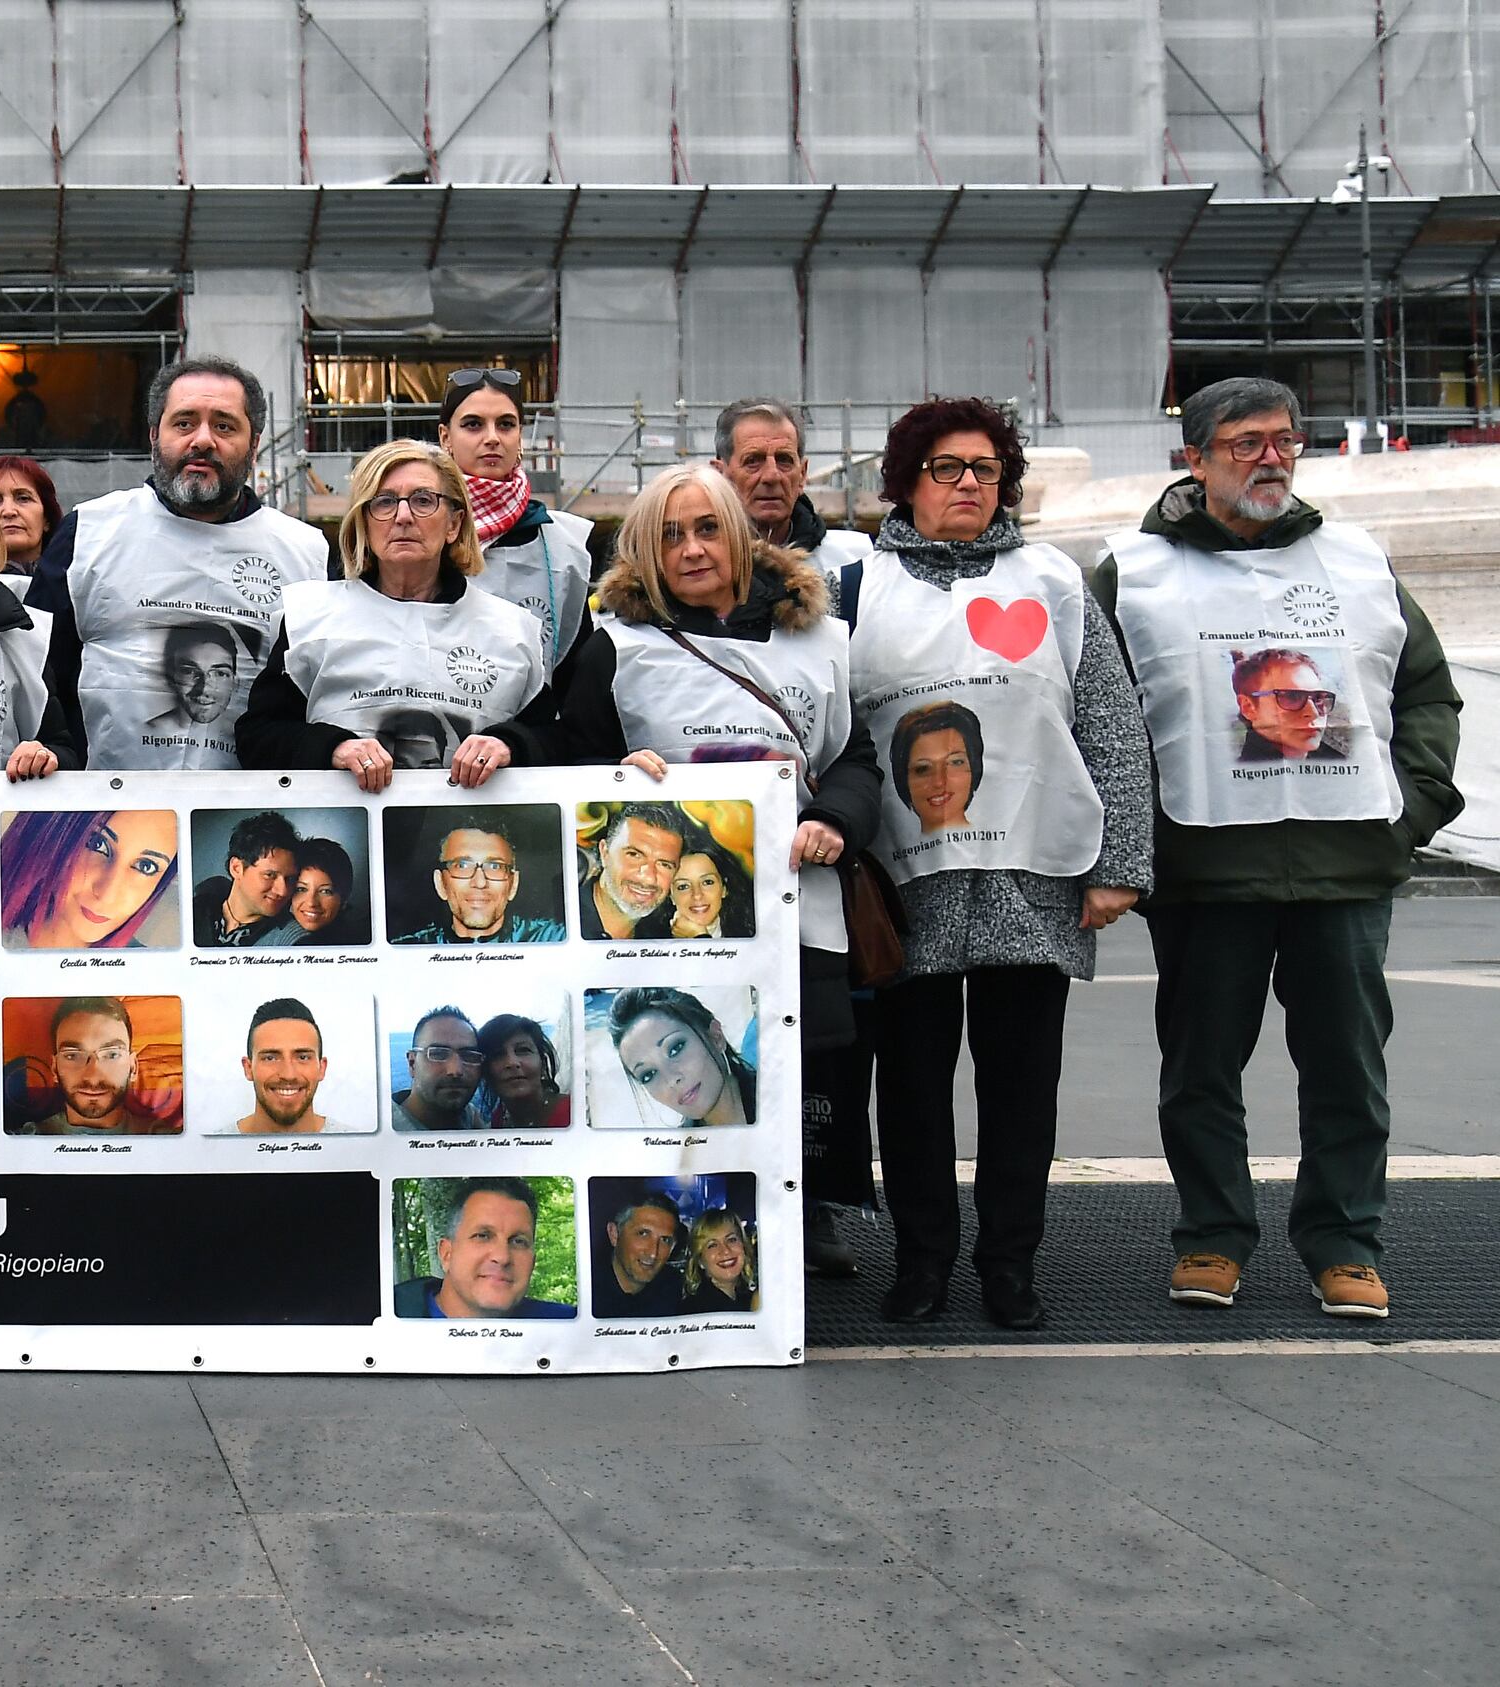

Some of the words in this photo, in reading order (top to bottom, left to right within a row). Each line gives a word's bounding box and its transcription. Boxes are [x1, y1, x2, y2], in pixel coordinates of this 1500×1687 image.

[137, 598, 192, 610] Alessandro
[195, 601, 235, 615] Riccetti,
[237, 608, 258, 619] anni
[260, 611, 271, 622] 33
[1199, 631, 1255, 641] Emanuele
[1258, 629, 1303, 640] Bonifazi,
[1306, 628, 1330, 639] anni
[1332, 628, 1345, 637] 31
[902, 679, 965, 698] Serraiocco,
[968, 675, 992, 685] anni
[995, 675, 1009, 685] 36
[351, 687, 402, 700] Alessandro
[406, 687, 447, 703] Riccetti,
[450, 695, 469, 707] anni
[471, 698, 482, 709] 33
[683, 725, 722, 736] Cecilia
[725, 725, 773, 739] Martella,
[142, 735, 199, 748] Rigopiano,
[1232, 766, 1294, 780] Rigopiano,
[1299, 765, 1360, 776] 18/01/2017
[428, 952, 473, 962] Alessandro
[476, 952, 524, 963] Giancaterino
[606, 949, 637, 960] Claudio
[640, 948, 670, 958] Baldini
[679, 948, 700, 958] Sara
[60, 958, 87, 968] Cecilia
[90, 958, 126, 967] Martella
[190, 956, 226, 965] Domenico
[229, 956, 241, 965] Di
[243, 956, 294, 967] Michelangelo
[303, 955, 334, 964] Marina
[337, 955, 378, 964] Serraiocco
[257, 1143, 288, 1153] Stefano
[291, 1142, 322, 1152] Feniello
[409, 1140, 435, 1148] Marco
[487, 1138, 510, 1148] Paola
[643, 1137, 681, 1146] Valentina
[54, 1144, 98, 1153] Alessandro
[101, 1144, 132, 1153] Riccetti
[449, 1328, 478, 1337] Roberto
[480, 1328, 496, 1337] Del
[499, 1328, 523, 1337] Rosso
[594, 1327, 636, 1337] Sebastiano
[639, 1327, 648, 1335] di
[651, 1327, 671, 1337] Carlo
